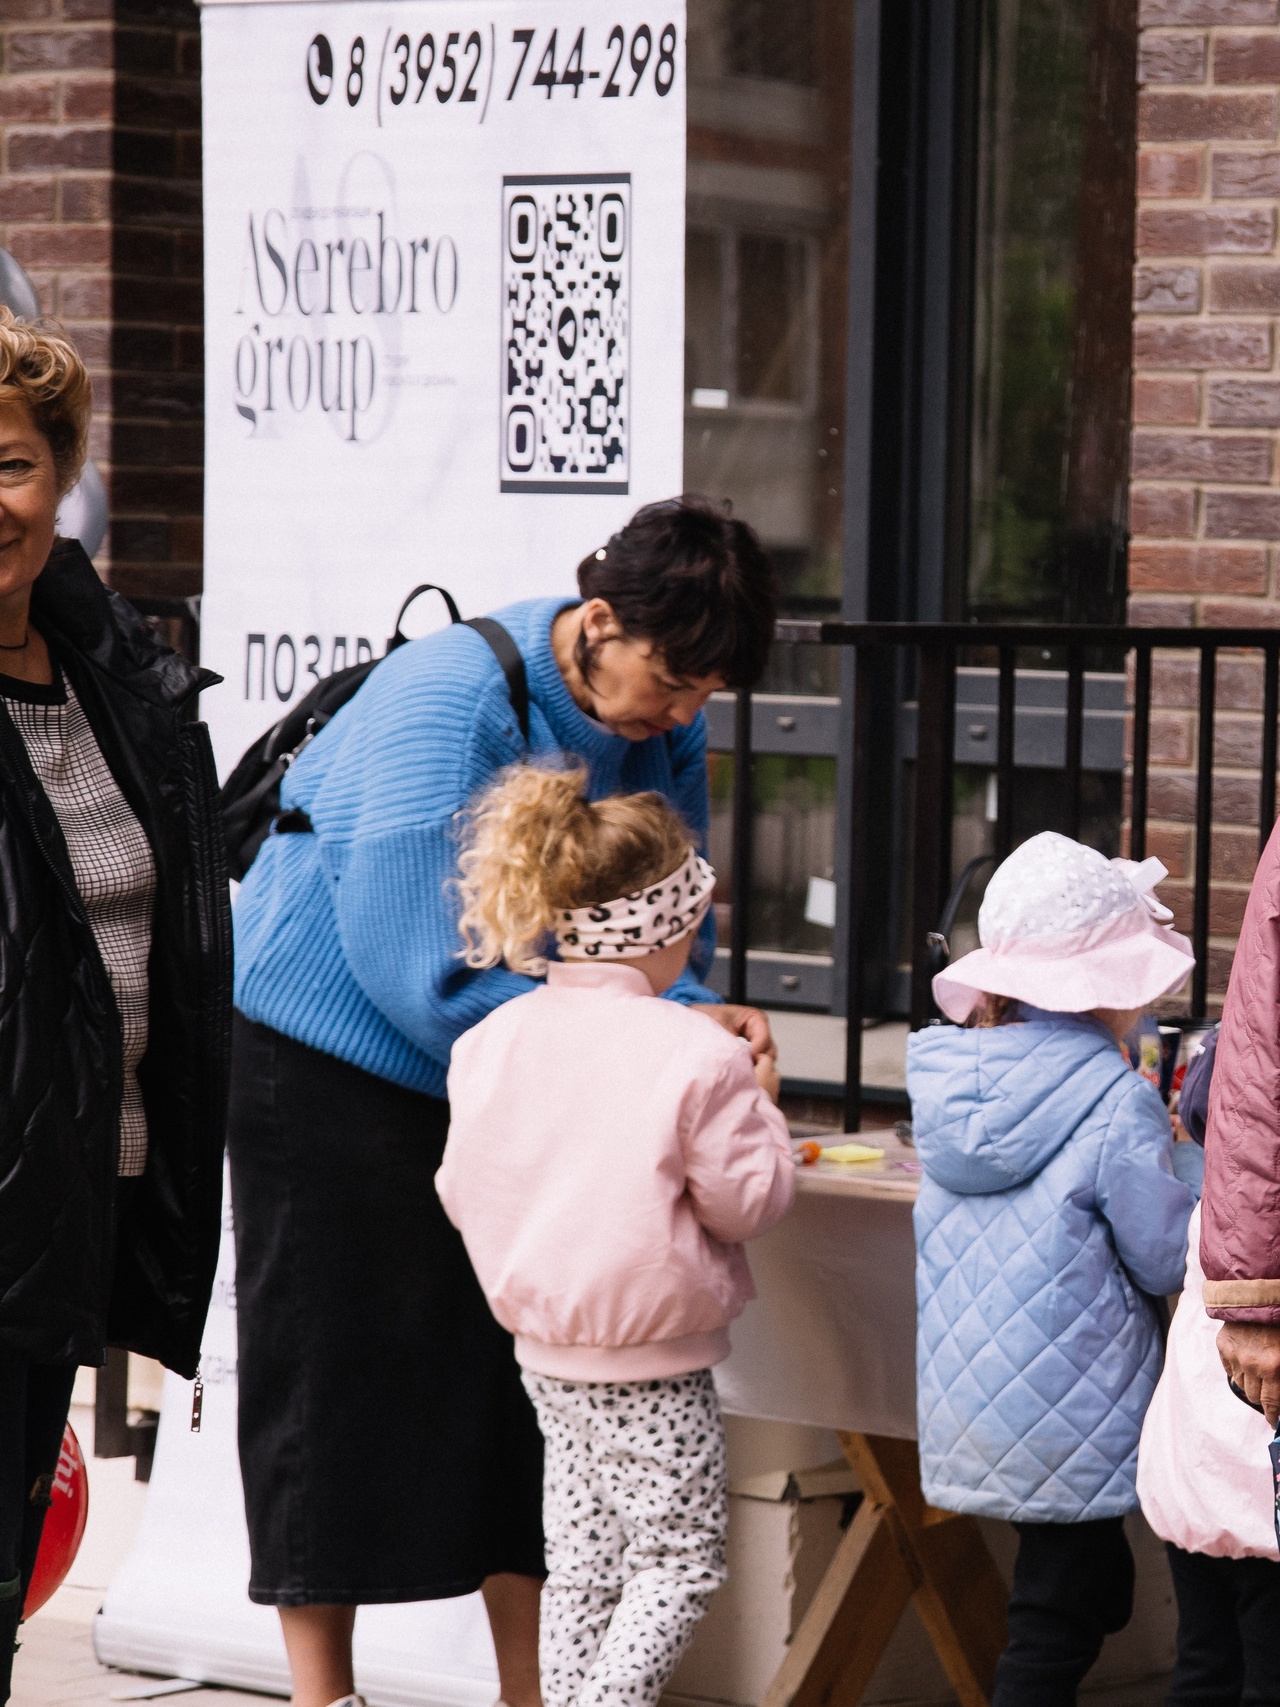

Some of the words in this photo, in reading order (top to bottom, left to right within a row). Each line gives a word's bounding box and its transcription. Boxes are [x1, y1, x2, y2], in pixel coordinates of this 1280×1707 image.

[347, 35, 365, 107] 8
[377, 22, 494, 128] (3952)
[506, 23, 676, 101] 744-298
[233, 322, 377, 442] group
